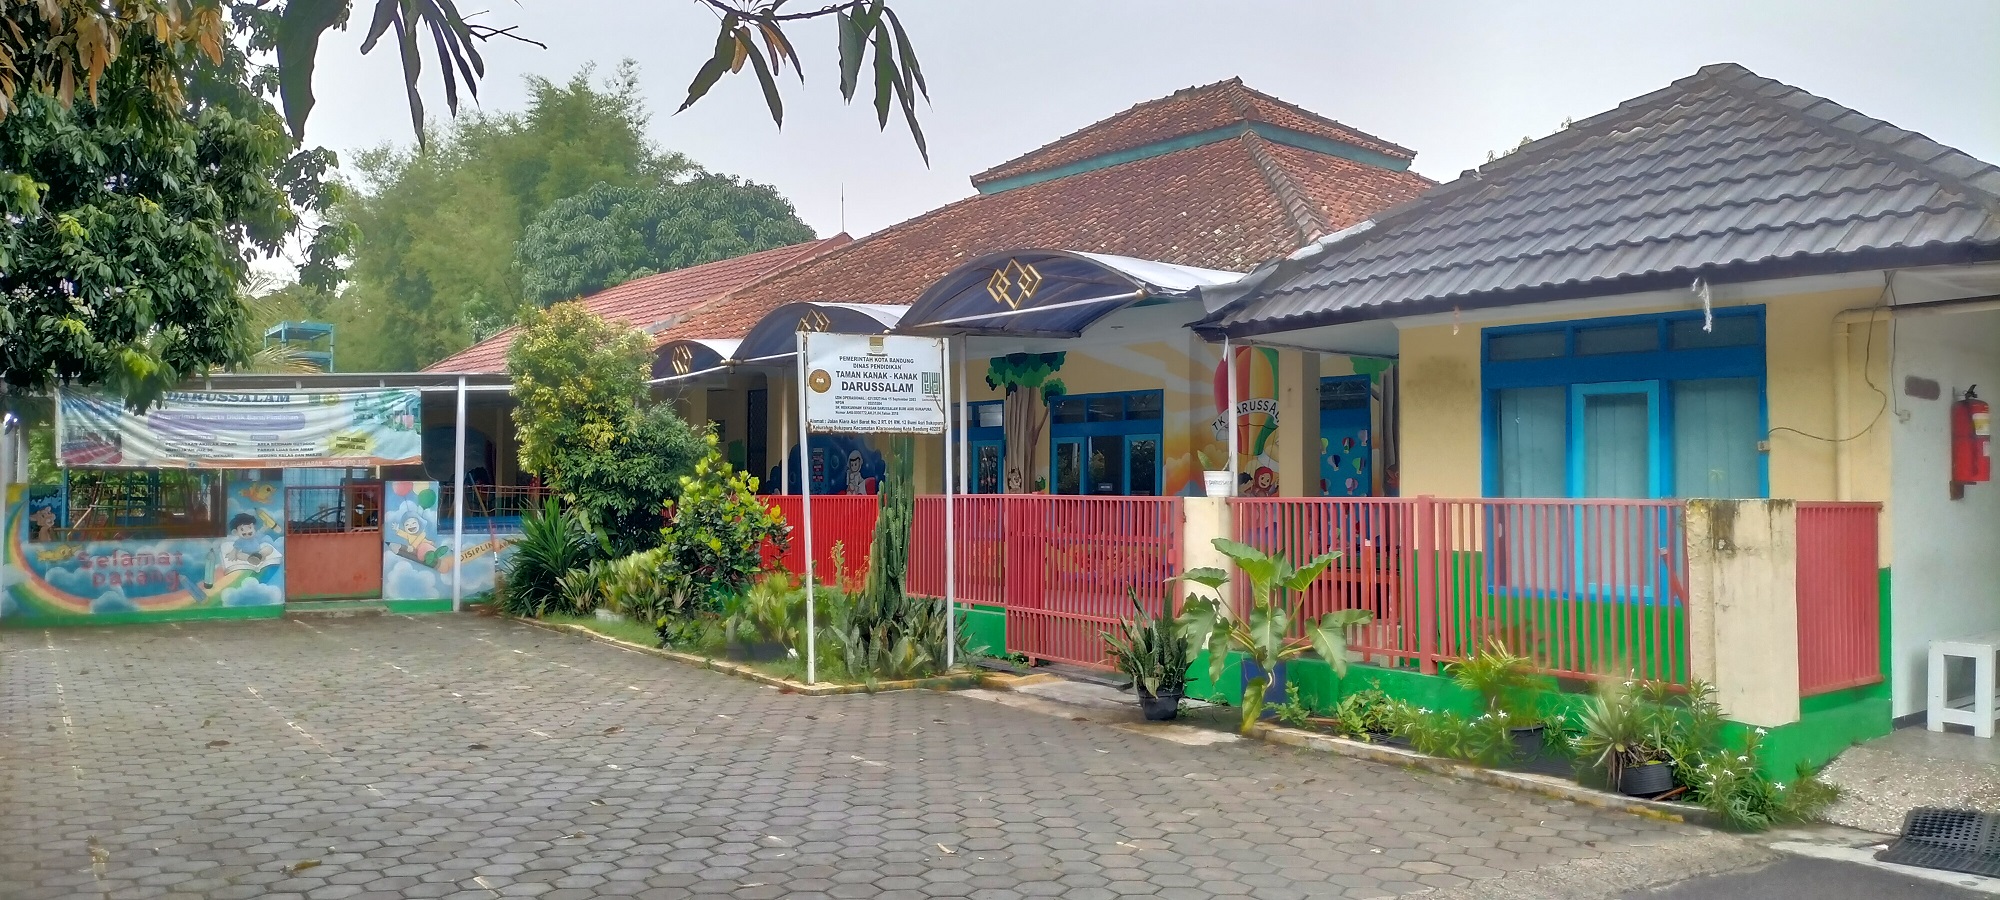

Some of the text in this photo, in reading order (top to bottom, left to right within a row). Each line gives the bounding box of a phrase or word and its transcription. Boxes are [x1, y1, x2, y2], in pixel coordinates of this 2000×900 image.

[839, 355, 874, 363] PEMERINTAH
[836, 370, 861, 379] TAMAN
[863, 371, 888, 380] KANAK
[893, 372, 918, 381] KANAK
[841, 381, 914, 393] DARUSSALAM
[167, 392, 291, 403] DARUSSALAM
[1211, 416, 1226, 431] TK
[280, 460, 323, 468] PENDAFTARAN
[77, 548, 184, 570] Selamat
